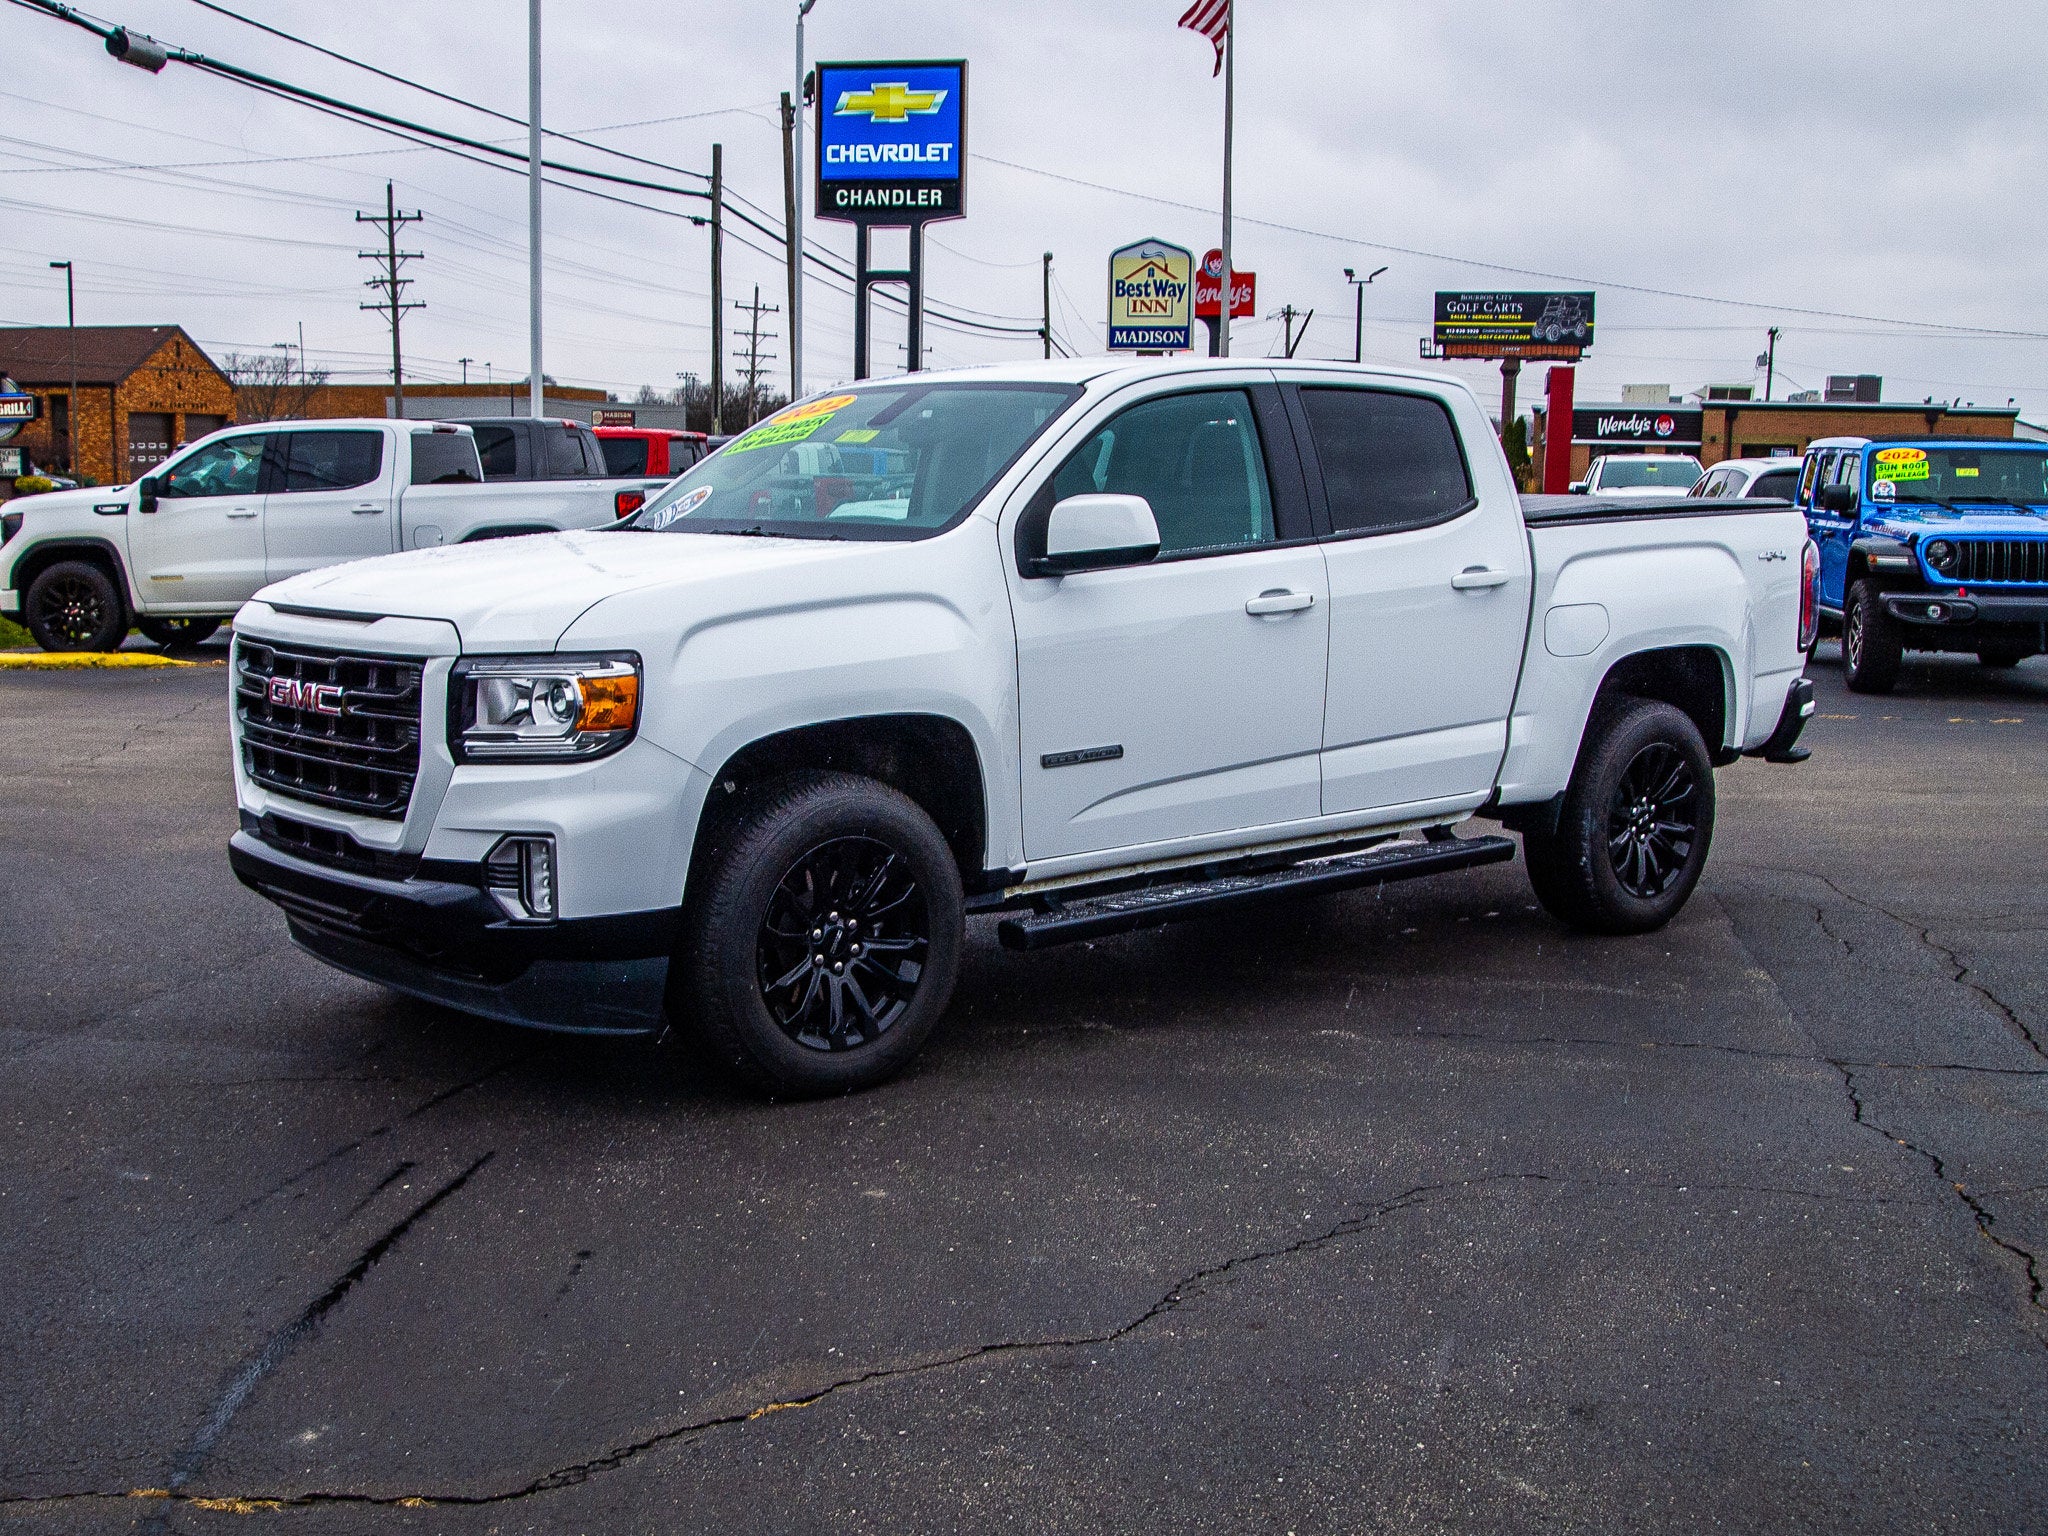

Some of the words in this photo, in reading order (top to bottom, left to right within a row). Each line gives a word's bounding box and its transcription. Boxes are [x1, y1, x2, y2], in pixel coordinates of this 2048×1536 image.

[826, 143, 953, 163] CHEVROLET
[836, 188, 943, 207] CHANDLER
[1131, 300, 1168, 314] INN
[1446, 301, 1480, 313] GOLF
[1483, 301, 1523, 313] CARTS
[1114, 330, 1185, 344] MADISON
[1598, 414, 1651, 436] Wendy's
[1882, 451, 1920, 460] 2024
[1879, 463, 1898, 471] SUN
[1902, 461, 1927, 470] ROOF
[1896, 470, 1927, 478] MILEAGE
[269, 676, 344, 716] GMC
